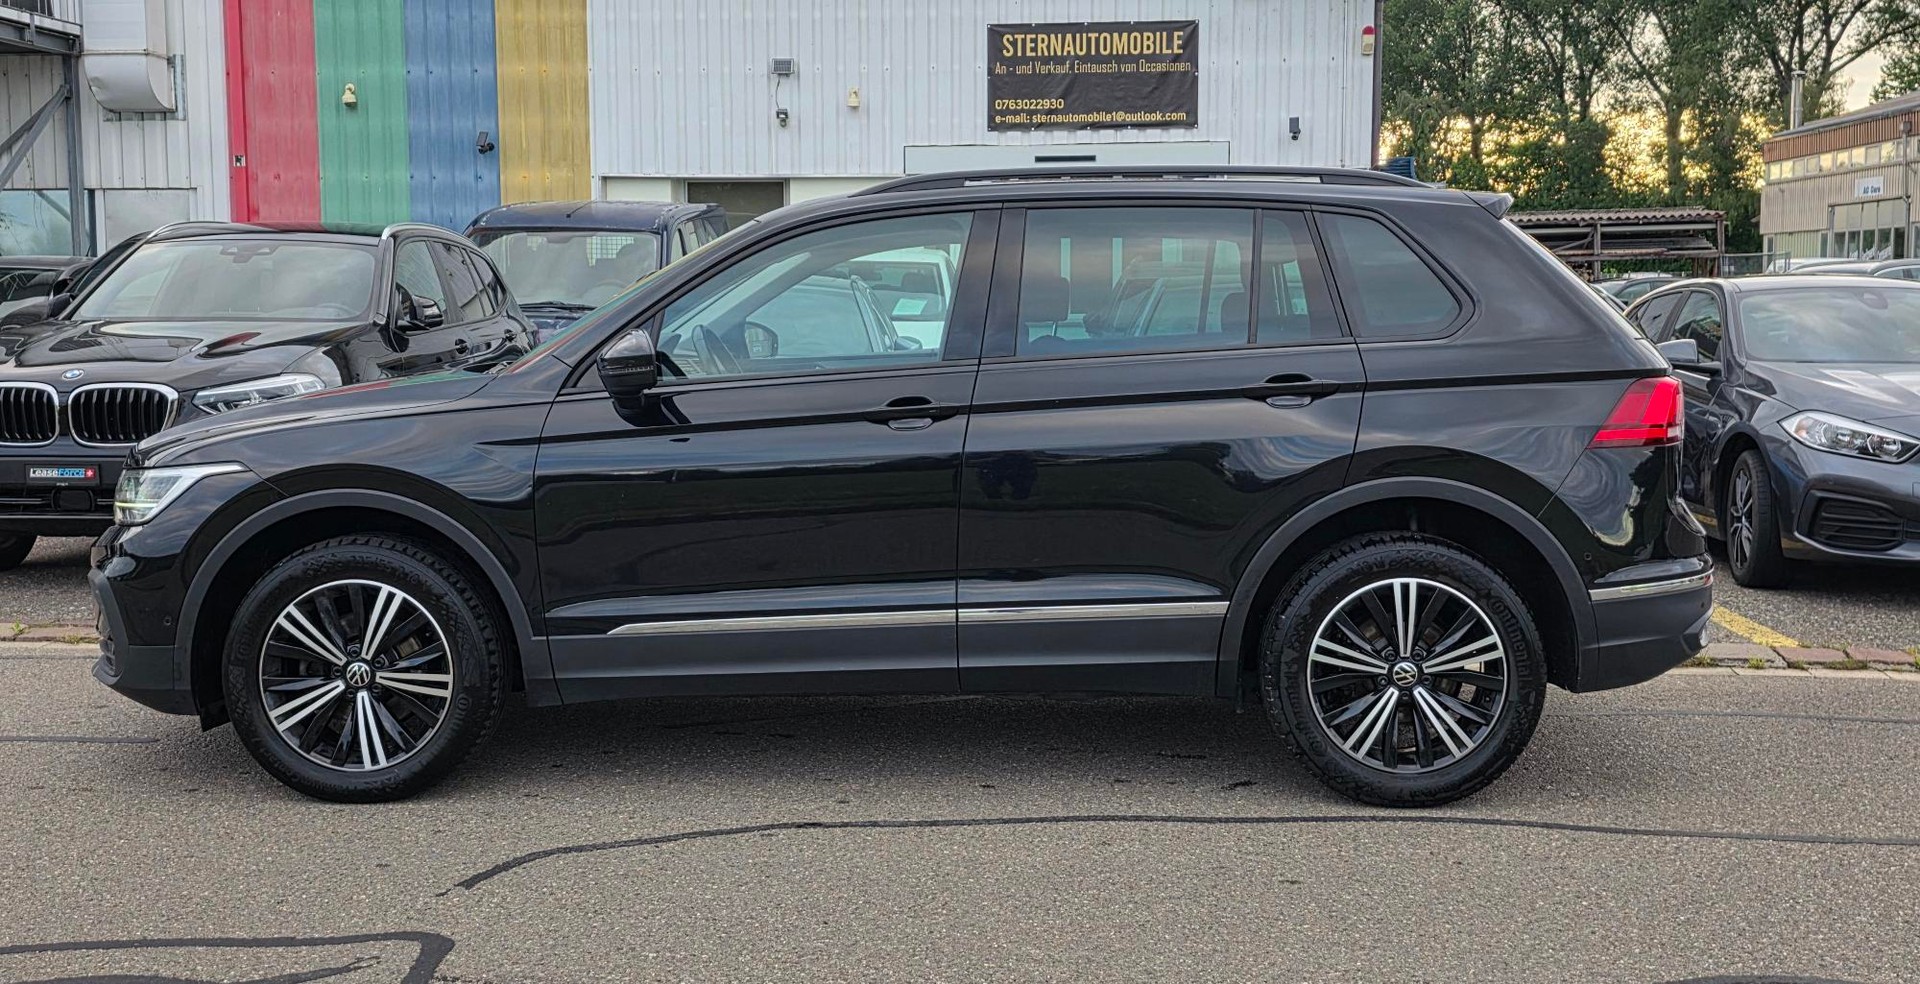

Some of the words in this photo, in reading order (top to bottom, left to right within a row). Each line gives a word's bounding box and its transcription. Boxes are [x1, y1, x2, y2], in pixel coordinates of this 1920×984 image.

[1002, 31, 1184, 57] STERNAUTOMOBILE
[995, 63, 1007, 75] An
[1016, 62, 1032, 75] und
[1075, 59, 1118, 73] Eintausch
[1120, 62, 1137, 72] von
[1139, 59, 1191, 72] Occasionen
[995, 99, 1065, 110] 0763022930
[995, 113, 1030, 124] e-mail:
[1032, 111, 1186, 123] sternautomobile1@outlook.com
